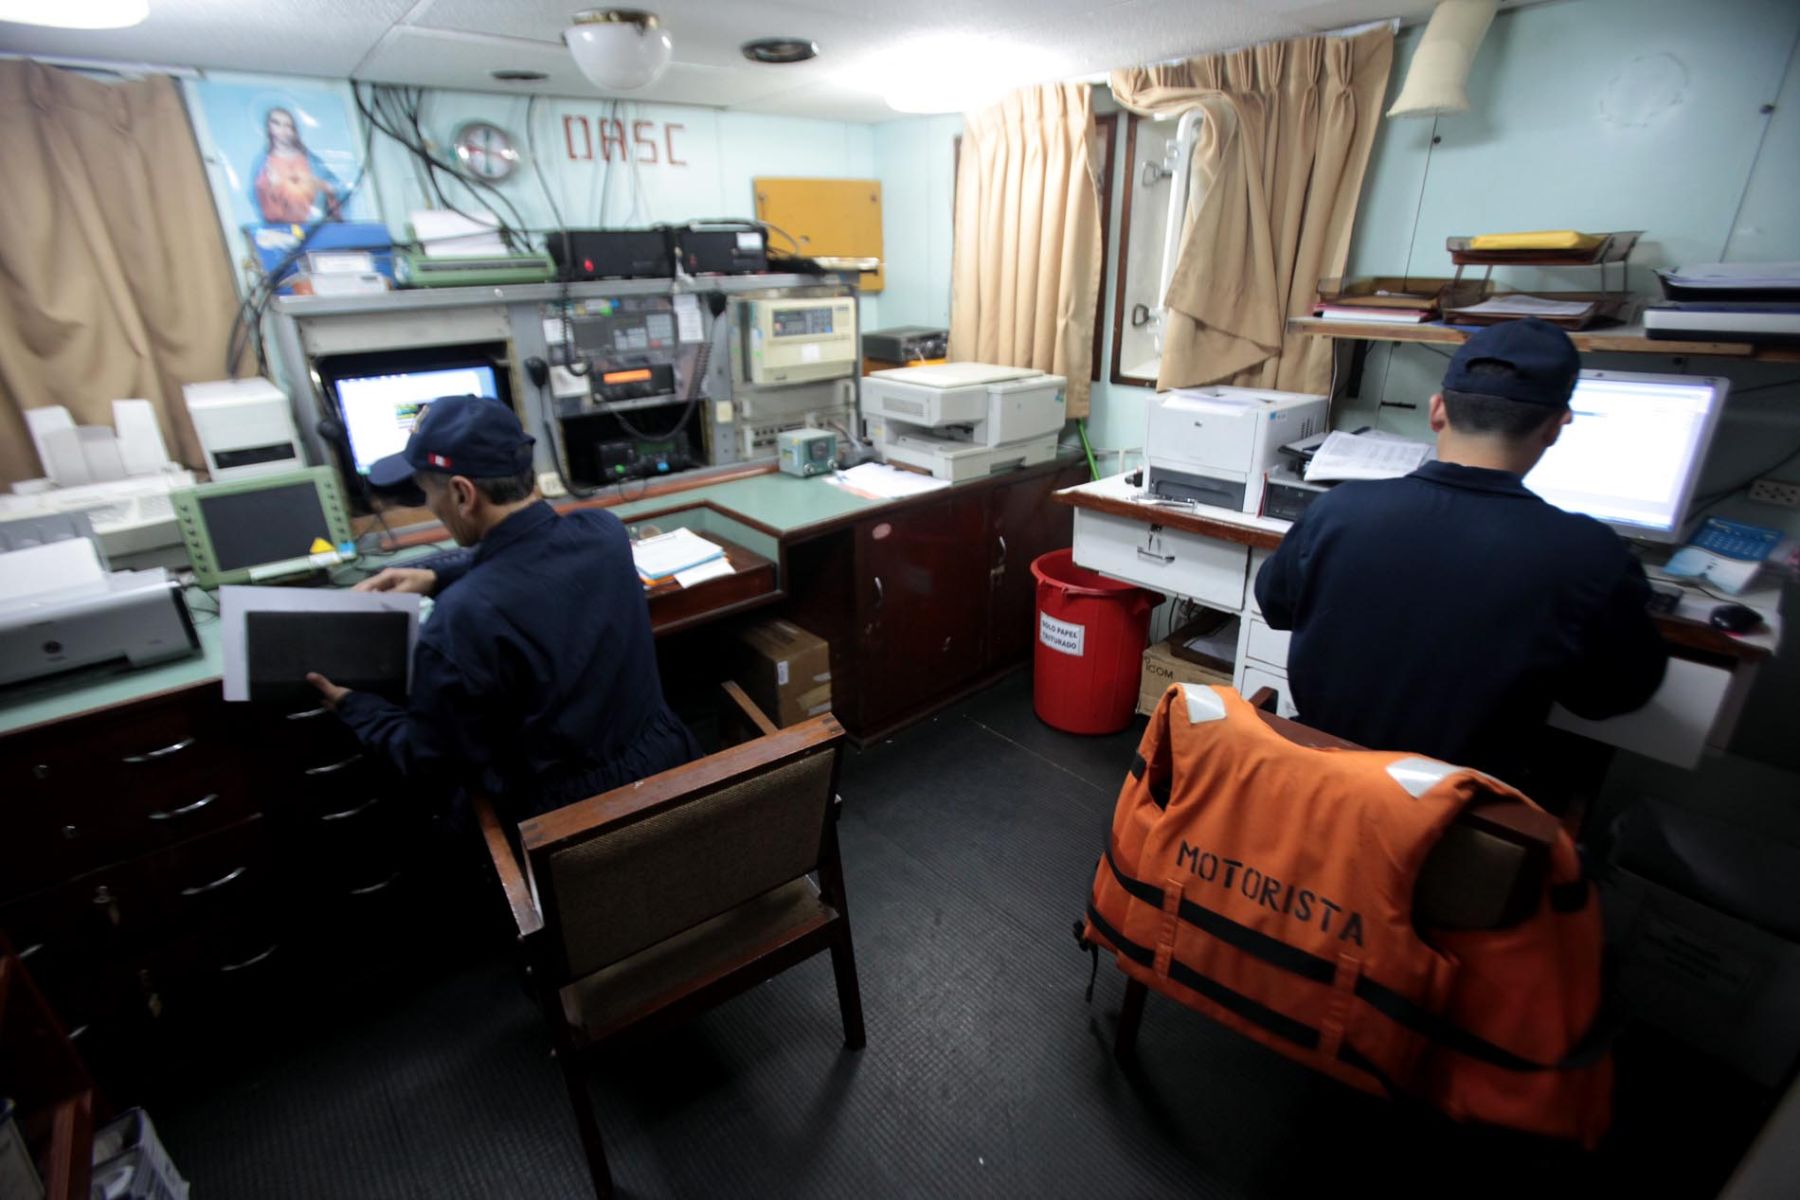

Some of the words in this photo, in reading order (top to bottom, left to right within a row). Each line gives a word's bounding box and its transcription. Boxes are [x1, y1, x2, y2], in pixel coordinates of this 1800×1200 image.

[1057, 627, 1078, 639] PAPEL
[1145, 663, 1174, 679] ICOM
[1176, 840, 1363, 947] MOTORISTA
